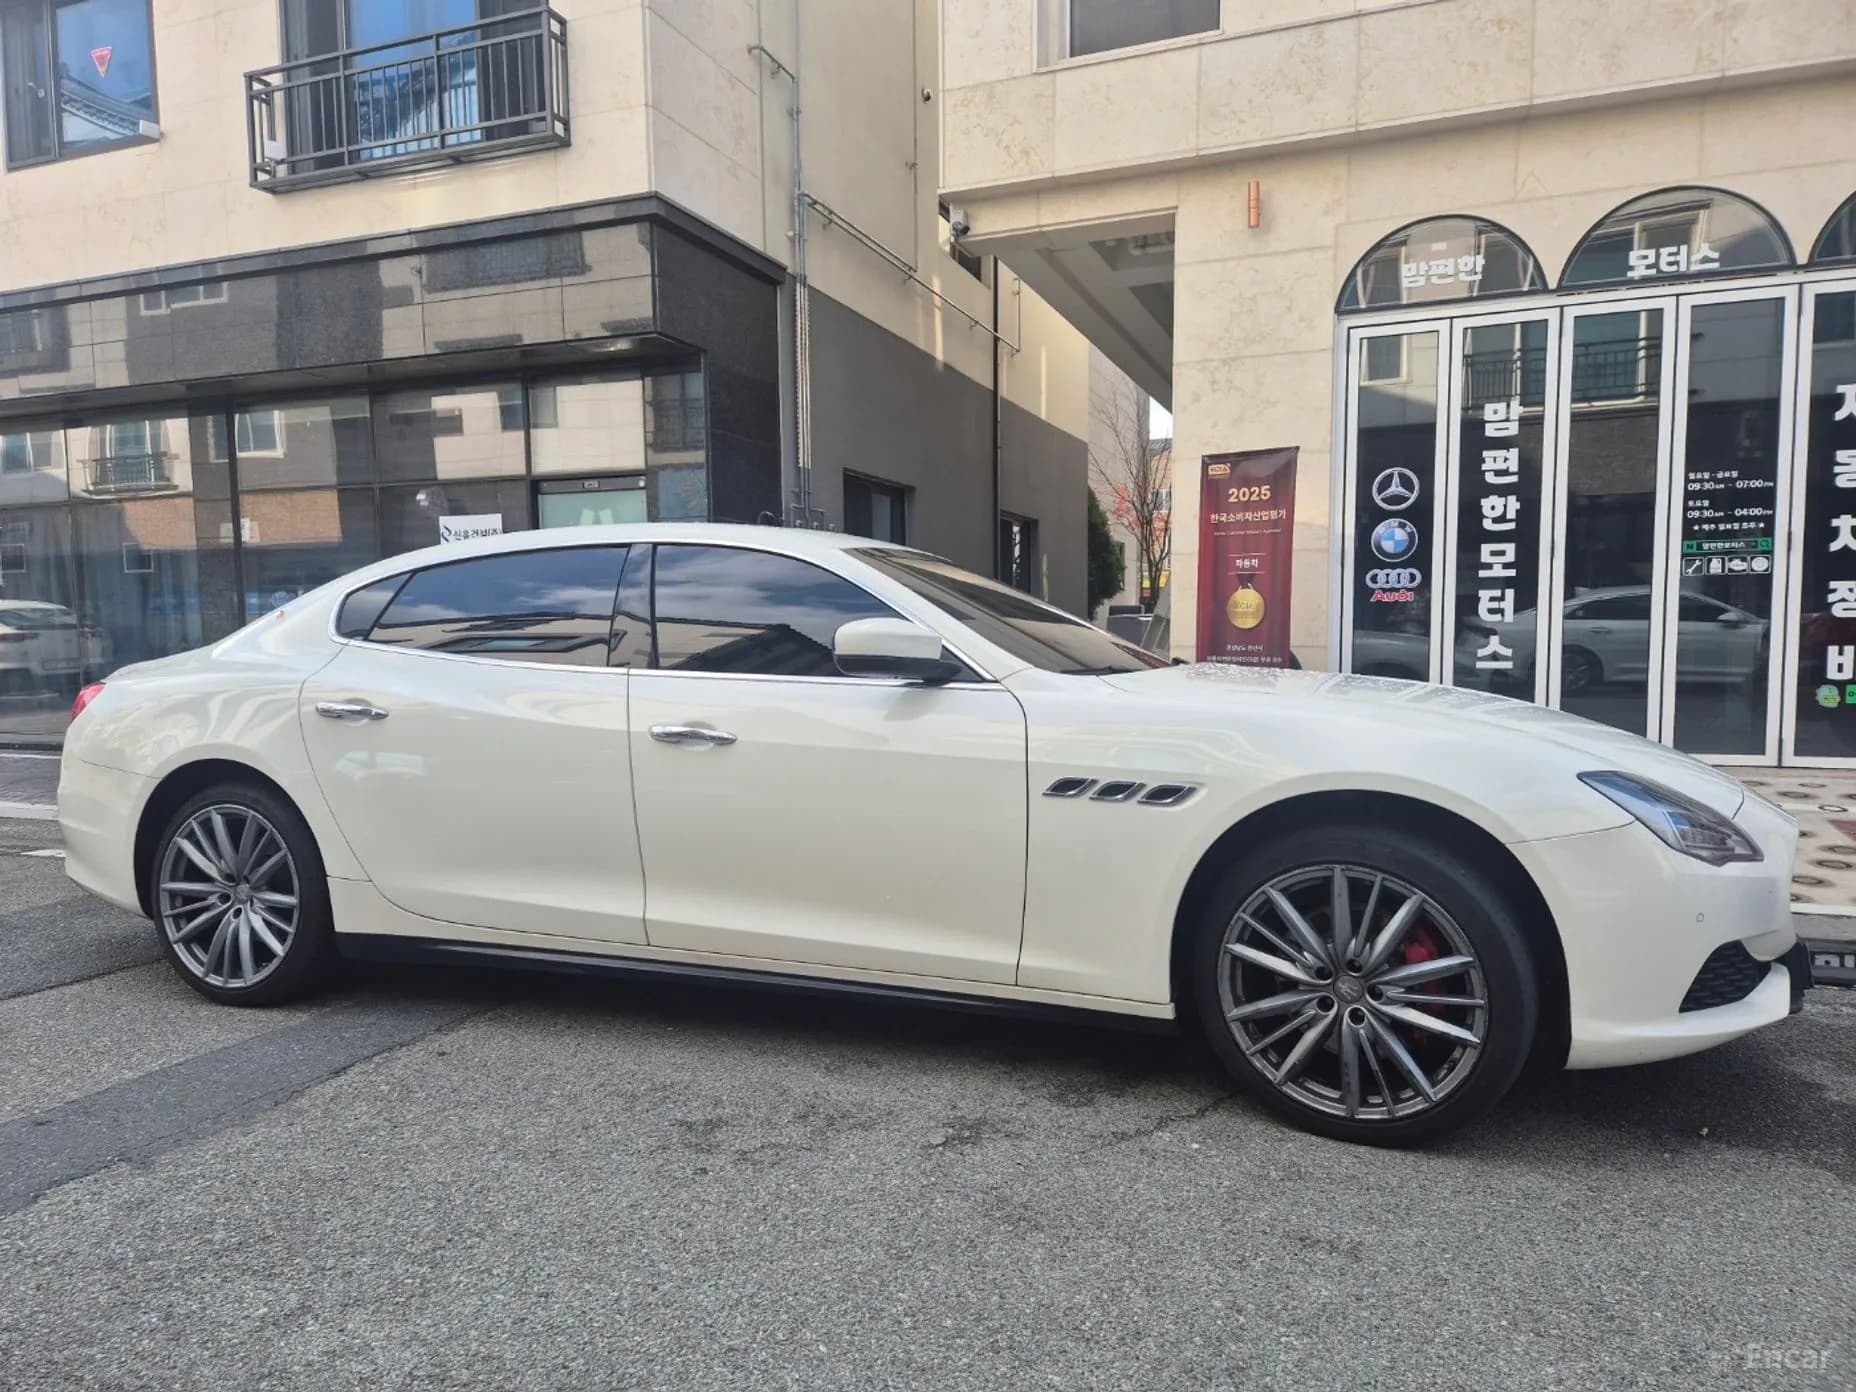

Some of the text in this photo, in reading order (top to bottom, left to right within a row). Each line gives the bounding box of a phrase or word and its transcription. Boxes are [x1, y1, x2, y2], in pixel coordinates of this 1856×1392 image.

[1402, 243, 1721, 288] 맘편한 모터스
[1228, 485, 1272, 503] 2025
[1476, 399, 1524, 669] 맘편한모터스
[1370, 589, 1415, 602] Audi
